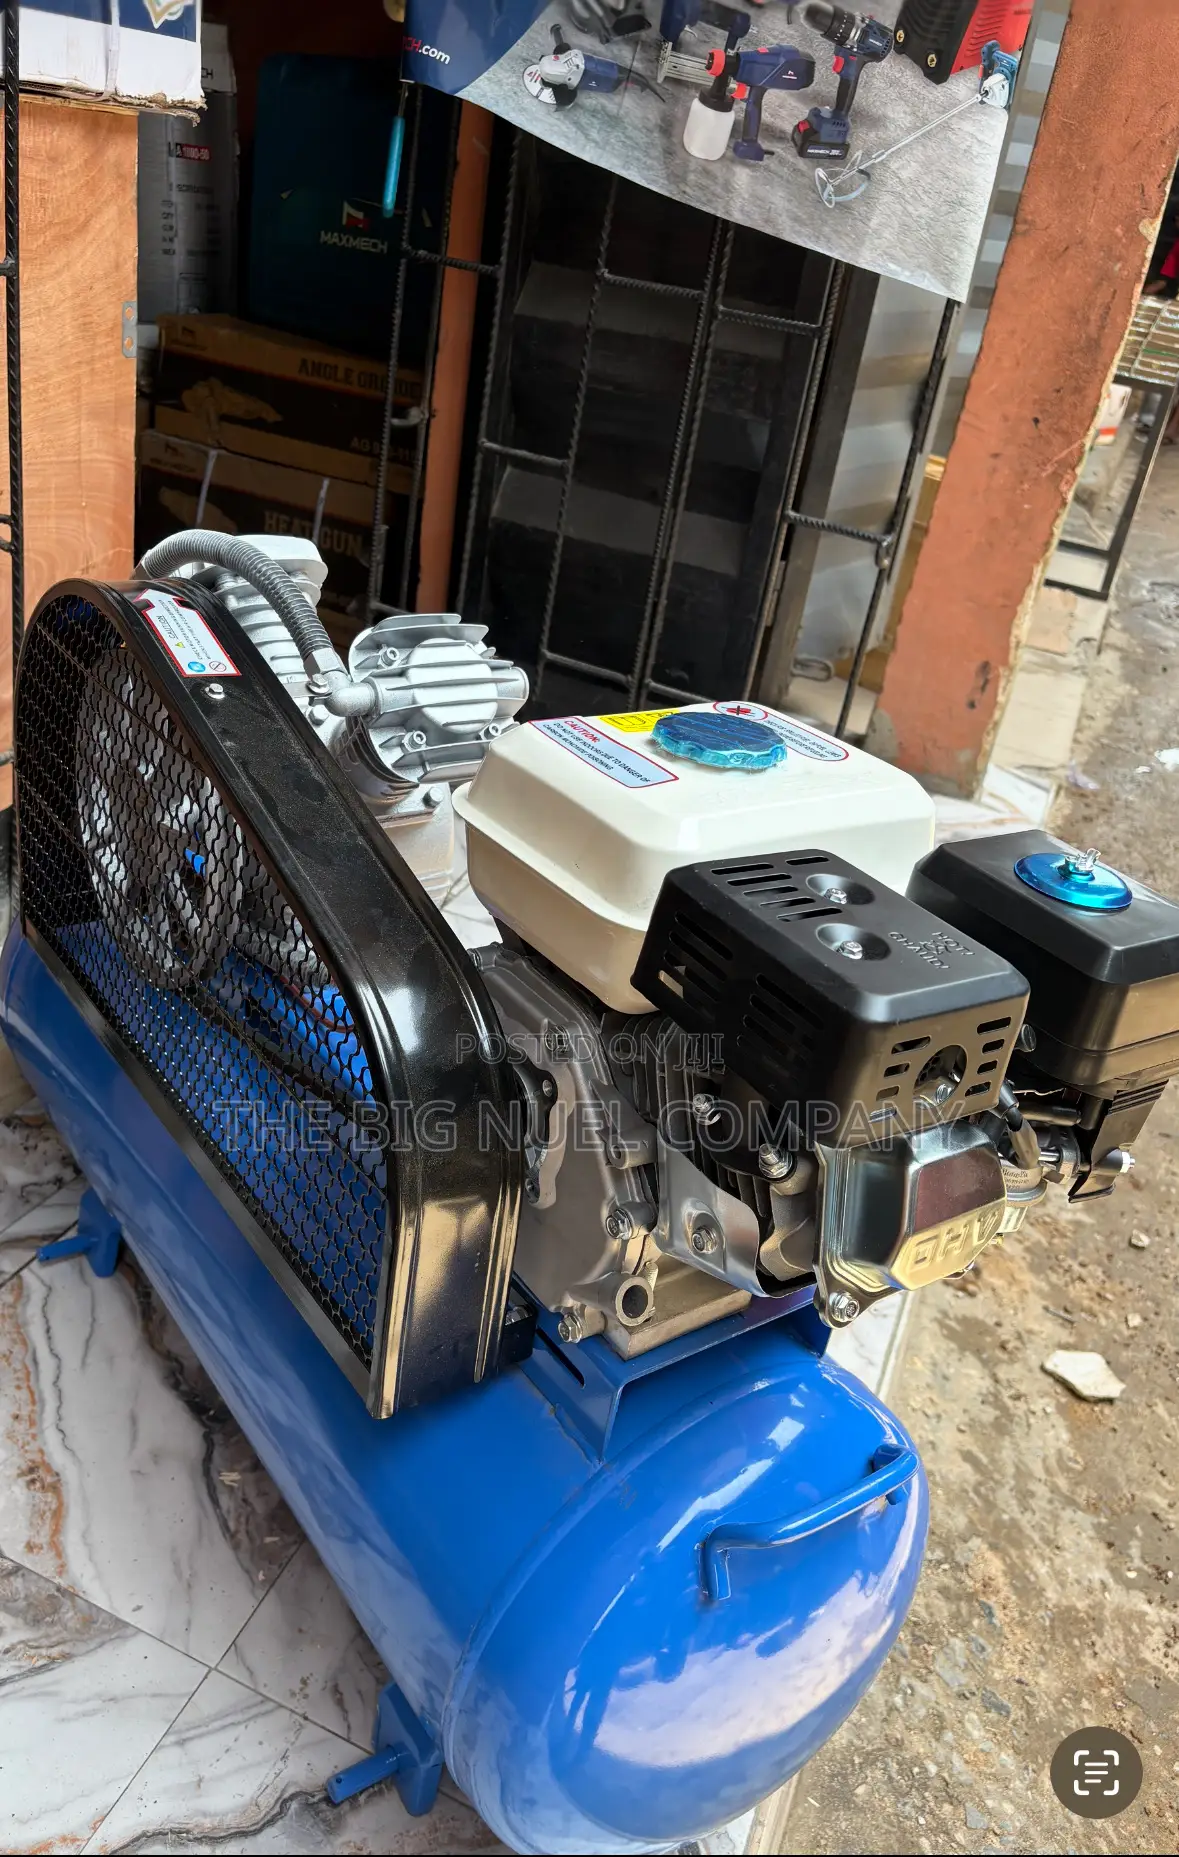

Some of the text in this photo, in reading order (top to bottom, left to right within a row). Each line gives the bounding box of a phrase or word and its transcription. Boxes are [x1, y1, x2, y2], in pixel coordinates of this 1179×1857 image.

[319, 229, 389, 255] MAXMECH
[298, 357, 355, 386] ANGLE
[320, 525, 363, 557] GUN
[888, 931, 951, 969] CHAUD!
[931, 931, 975, 956] HOT!
